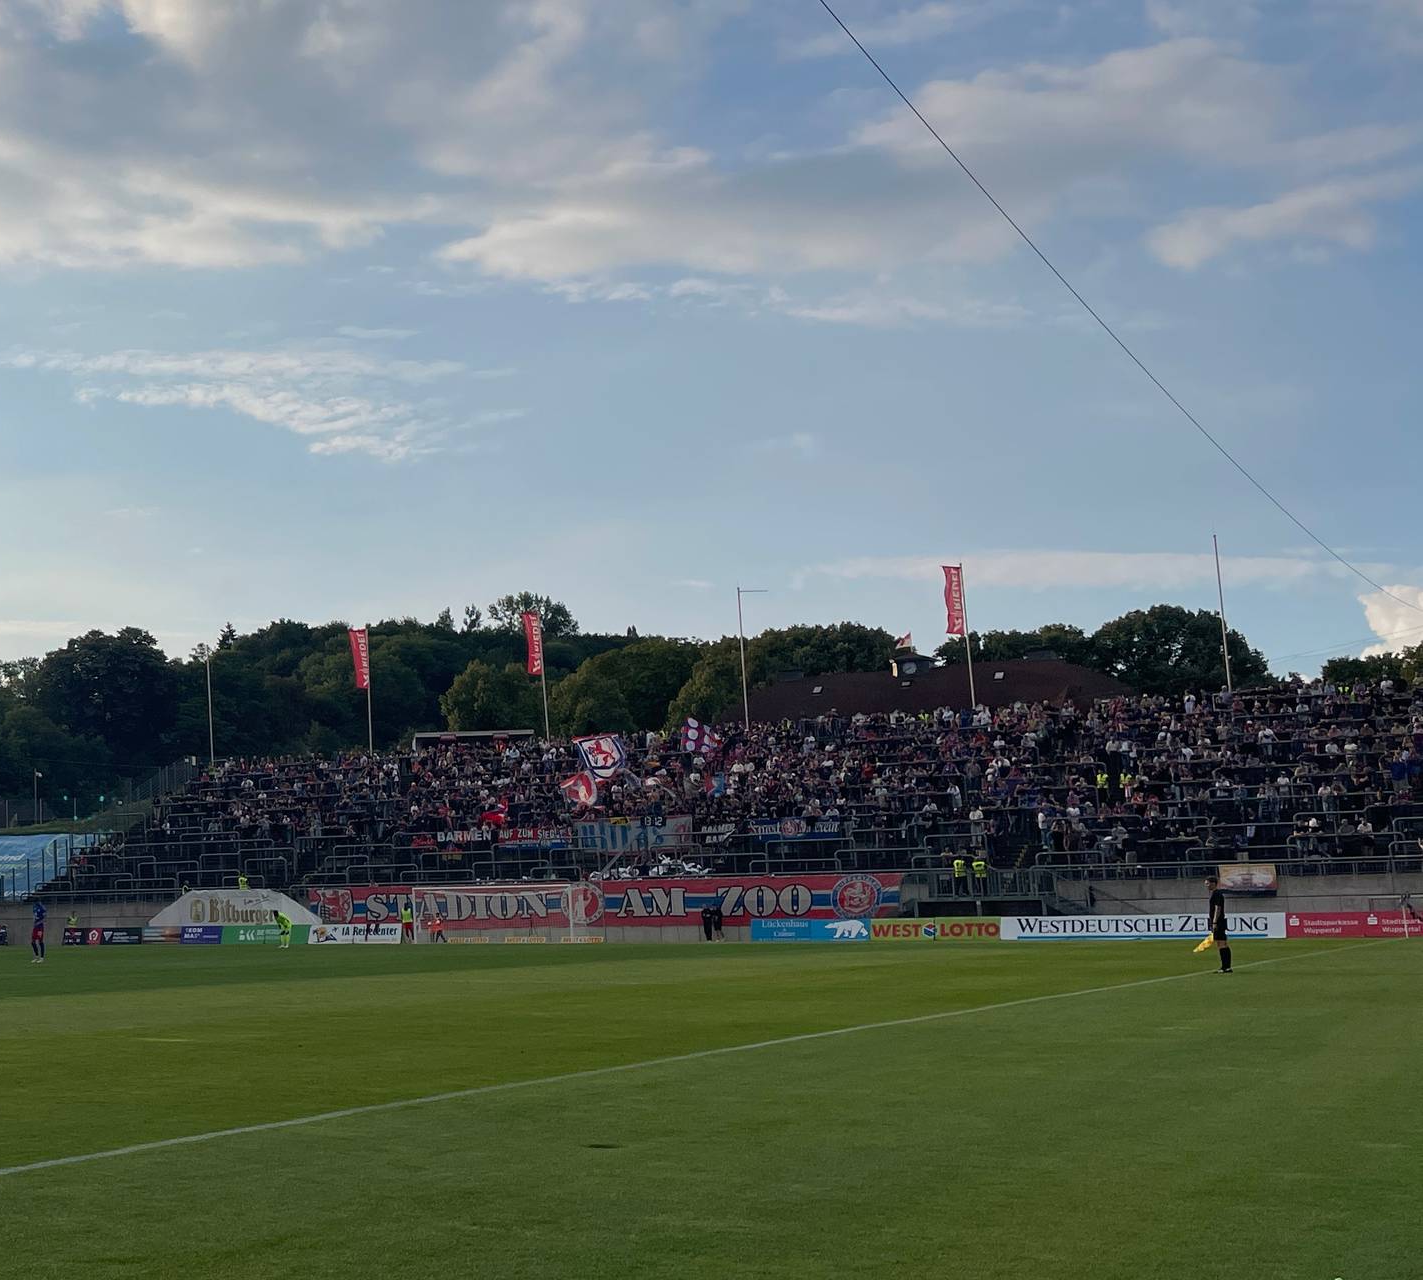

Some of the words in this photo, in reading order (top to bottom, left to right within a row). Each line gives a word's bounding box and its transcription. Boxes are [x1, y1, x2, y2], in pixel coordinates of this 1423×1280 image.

[437, 830, 491, 842] BARMEN
[499, 829, 514, 839] AUF
[517, 828, 534, 839] ZUM
[366, 892, 549, 921] STADION
[617, 886, 687, 918] AM
[716, 884, 813, 917] ZOO
[209, 899, 275, 925] Bitburger
[872, 923, 921, 937] WEST
[940, 922, 1000, 937] LOTTO
[1017, 918, 1175, 934] WESTDEUTSCHE
[1178, 915, 1268, 933] ZEIUNG
[1303, 919, 1359, 927] Stadtsparkasse
